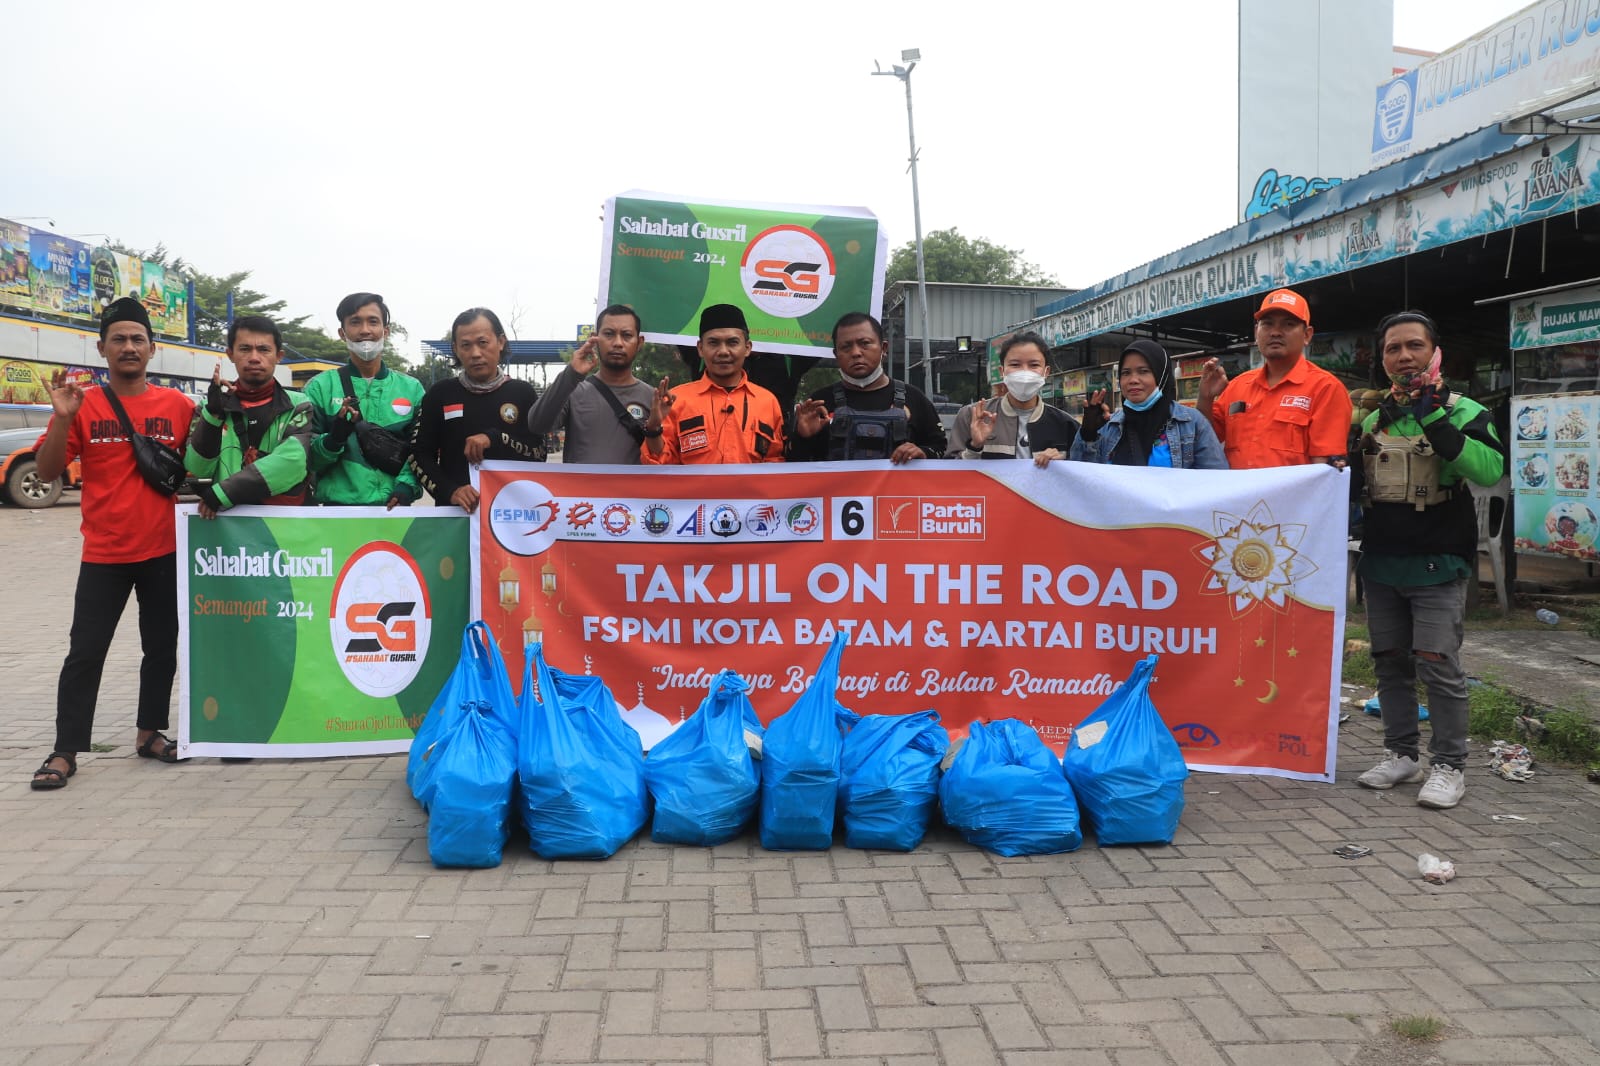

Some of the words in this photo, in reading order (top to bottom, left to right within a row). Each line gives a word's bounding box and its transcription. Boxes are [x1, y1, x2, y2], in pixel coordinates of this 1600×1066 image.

[1416, 17, 1535, 116] KULINER
[1461, 162, 1519, 192] WINGSFOOD
[1531, 159, 1553, 179] Teh
[1521, 166, 1584, 211] JAVANA
[619, 216, 689, 238] Sahabat
[691, 222, 747, 243] Gusril
[617, 242, 685, 263] Semangat
[692, 252, 727, 266] 2024
[1346, 231, 1381, 261] JAVANA
[752, 259, 821, 293] SG
[1061, 309, 1096, 339] SELAMAT
[1096, 292, 1133, 328] DATANG
[1135, 287, 1146, 317] DI
[1149, 270, 1203, 313] SIMPANG
[1207, 252, 1259, 298] RUJAK
[1543, 312, 1576, 327] RUJAK
[494, 509, 541, 521] FSPMI
[841, 500, 865, 536] 6
[922, 503, 982, 518] Partai
[922, 519, 982, 534] Buruh
[194, 546, 272, 577] Sahabat
[273, 547, 334, 578] Gusril
[616, 563, 791, 603] TAKJIL
[807, 563, 887, 605] ON
[905, 564, 1002, 604] THE
[1022, 564, 1178, 610] ROAD
[194, 594, 268, 623] Semangat
[276, 601, 314, 621] 2024
[345, 602, 416, 652] SG
[582, 616, 680, 643] FSPMI
[693, 618, 783, 645] KOTA
[795, 618, 912, 647] BATAM
[924, 620, 949, 648] &
[961, 620, 1082, 648] PARTAI
[1095, 623, 1217, 654] BURUH
[390, 653, 416, 663] GUSRIL
[884, 671, 911, 692] di
[915, 668, 998, 696] Bulan
[1279, 741, 1312, 757] POL
